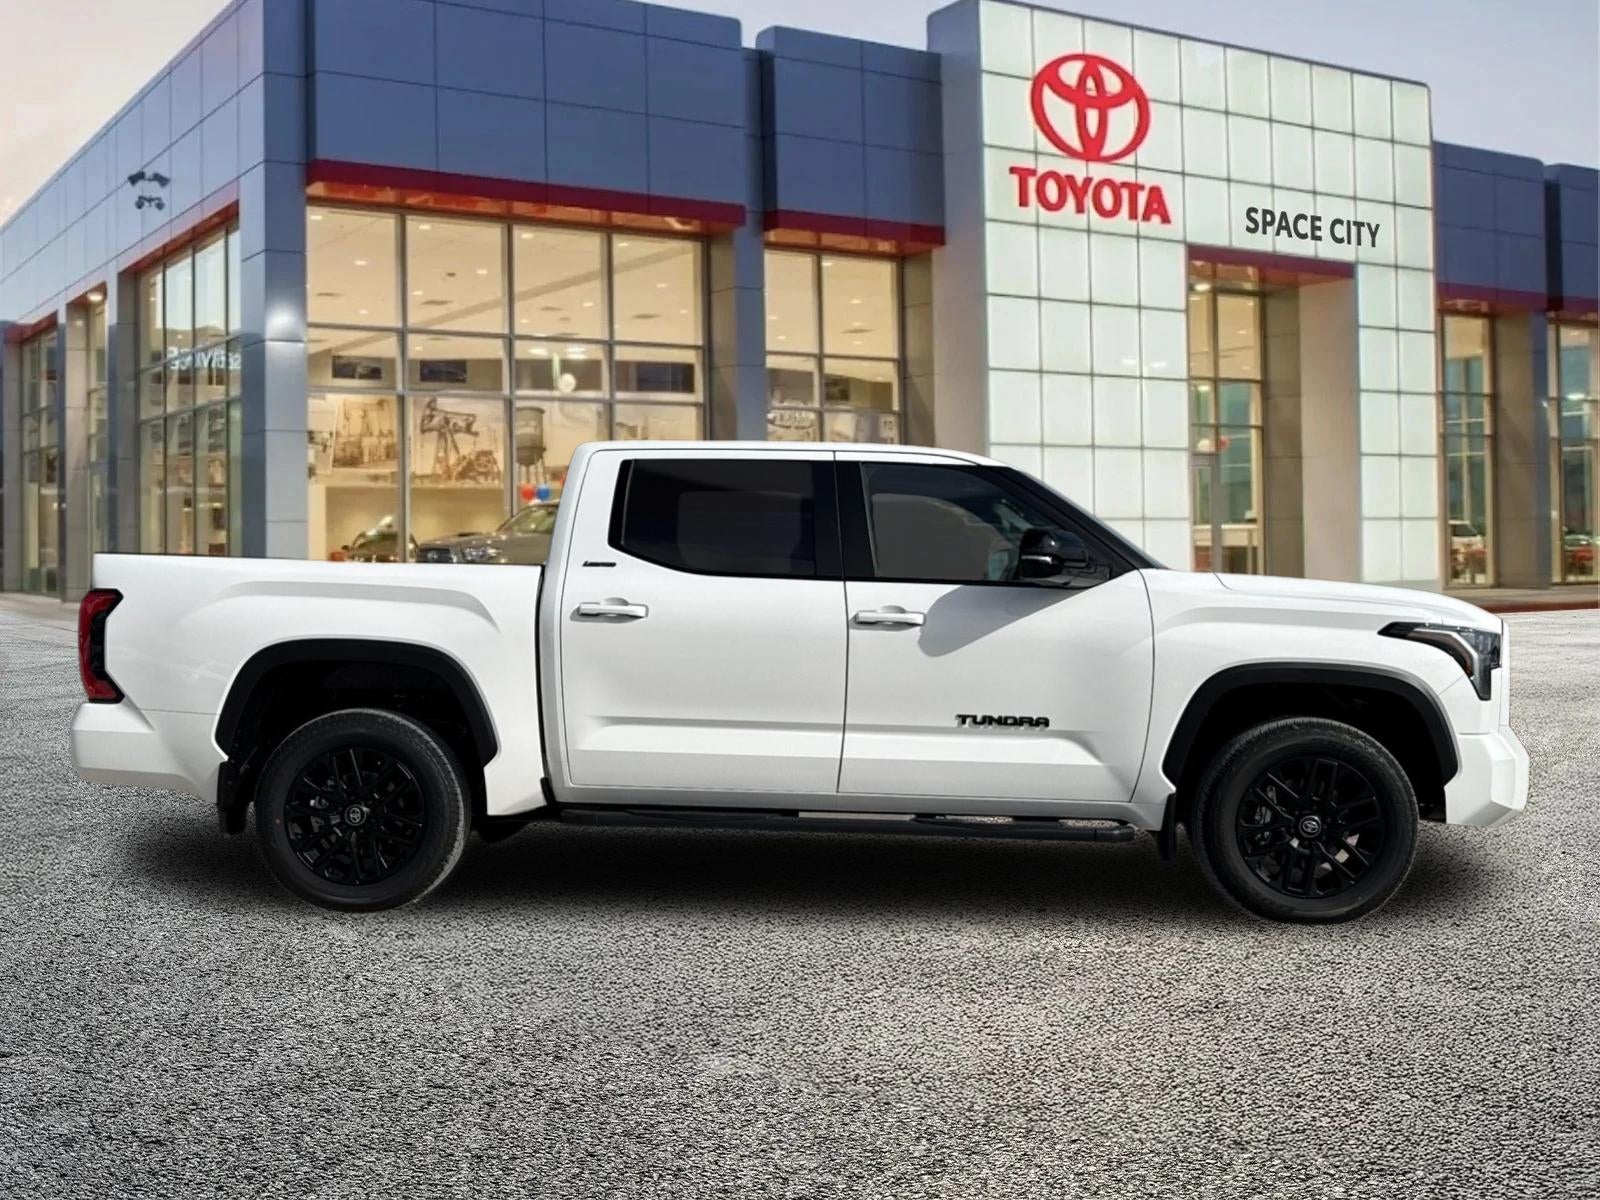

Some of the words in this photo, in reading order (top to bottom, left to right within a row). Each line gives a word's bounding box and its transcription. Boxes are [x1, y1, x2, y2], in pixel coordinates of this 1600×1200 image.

[1009, 166, 1171, 225] TOYOTA
[1245, 206, 1322, 241] SPACE
[1329, 218, 1380, 247] CITY
[955, 714, 1050, 728] TUNDRA
